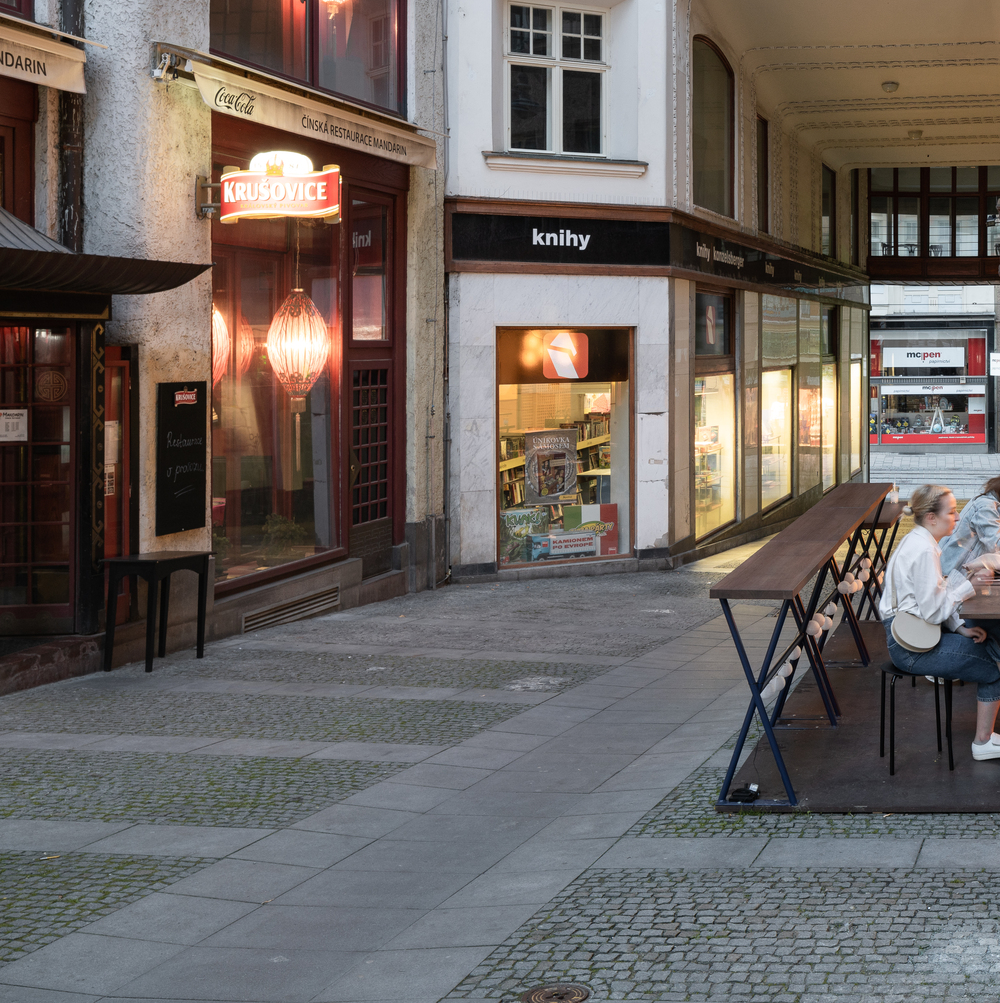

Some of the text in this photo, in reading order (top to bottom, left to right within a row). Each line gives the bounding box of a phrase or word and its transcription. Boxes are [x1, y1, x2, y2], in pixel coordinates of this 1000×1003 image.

[301, 114, 407, 156] ČÍNSKÁ RESTAURACE MANDARIN
[223, 178, 328, 203] KRUŠOVICE
[532, 228, 591, 251] knihy
[696, 241, 711, 262] knihy
[552, 537, 594, 545] KAMIONEM
[564, 541, 594, 549] EVROPE
